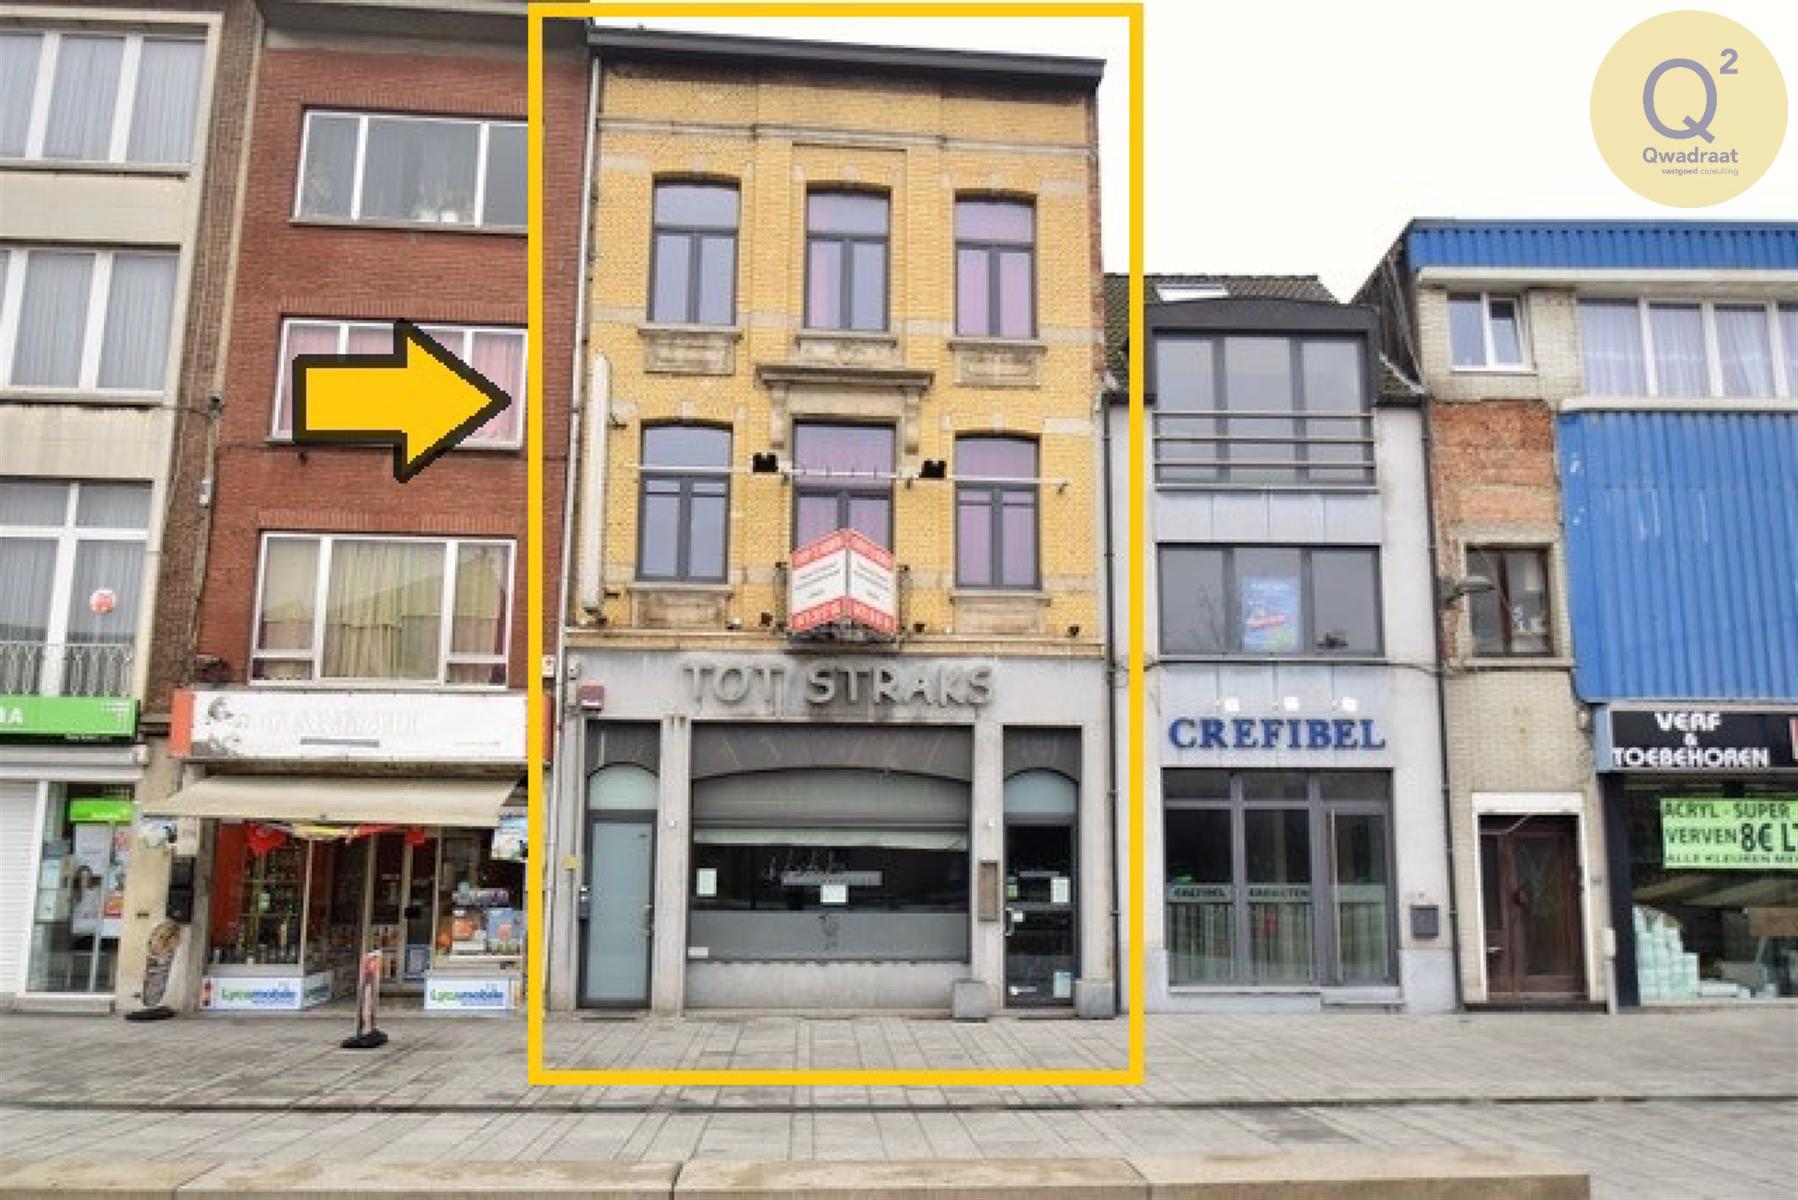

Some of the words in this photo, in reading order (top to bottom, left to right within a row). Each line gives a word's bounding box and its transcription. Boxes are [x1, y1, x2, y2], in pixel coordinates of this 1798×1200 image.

[682, 664, 788, 706] TOT
[807, 665, 993, 707] STRAKS
[1655, 712, 1723, 731] VERF
[1167, 718, 1386, 749] CREFIBEL
[1612, 747, 1770, 768] TOEBEHOREN
[1664, 802, 1719, 818] ACRYL
[1732, 802, 1791, 819] SUPER
[1665, 828, 1738, 844] VERVEN
